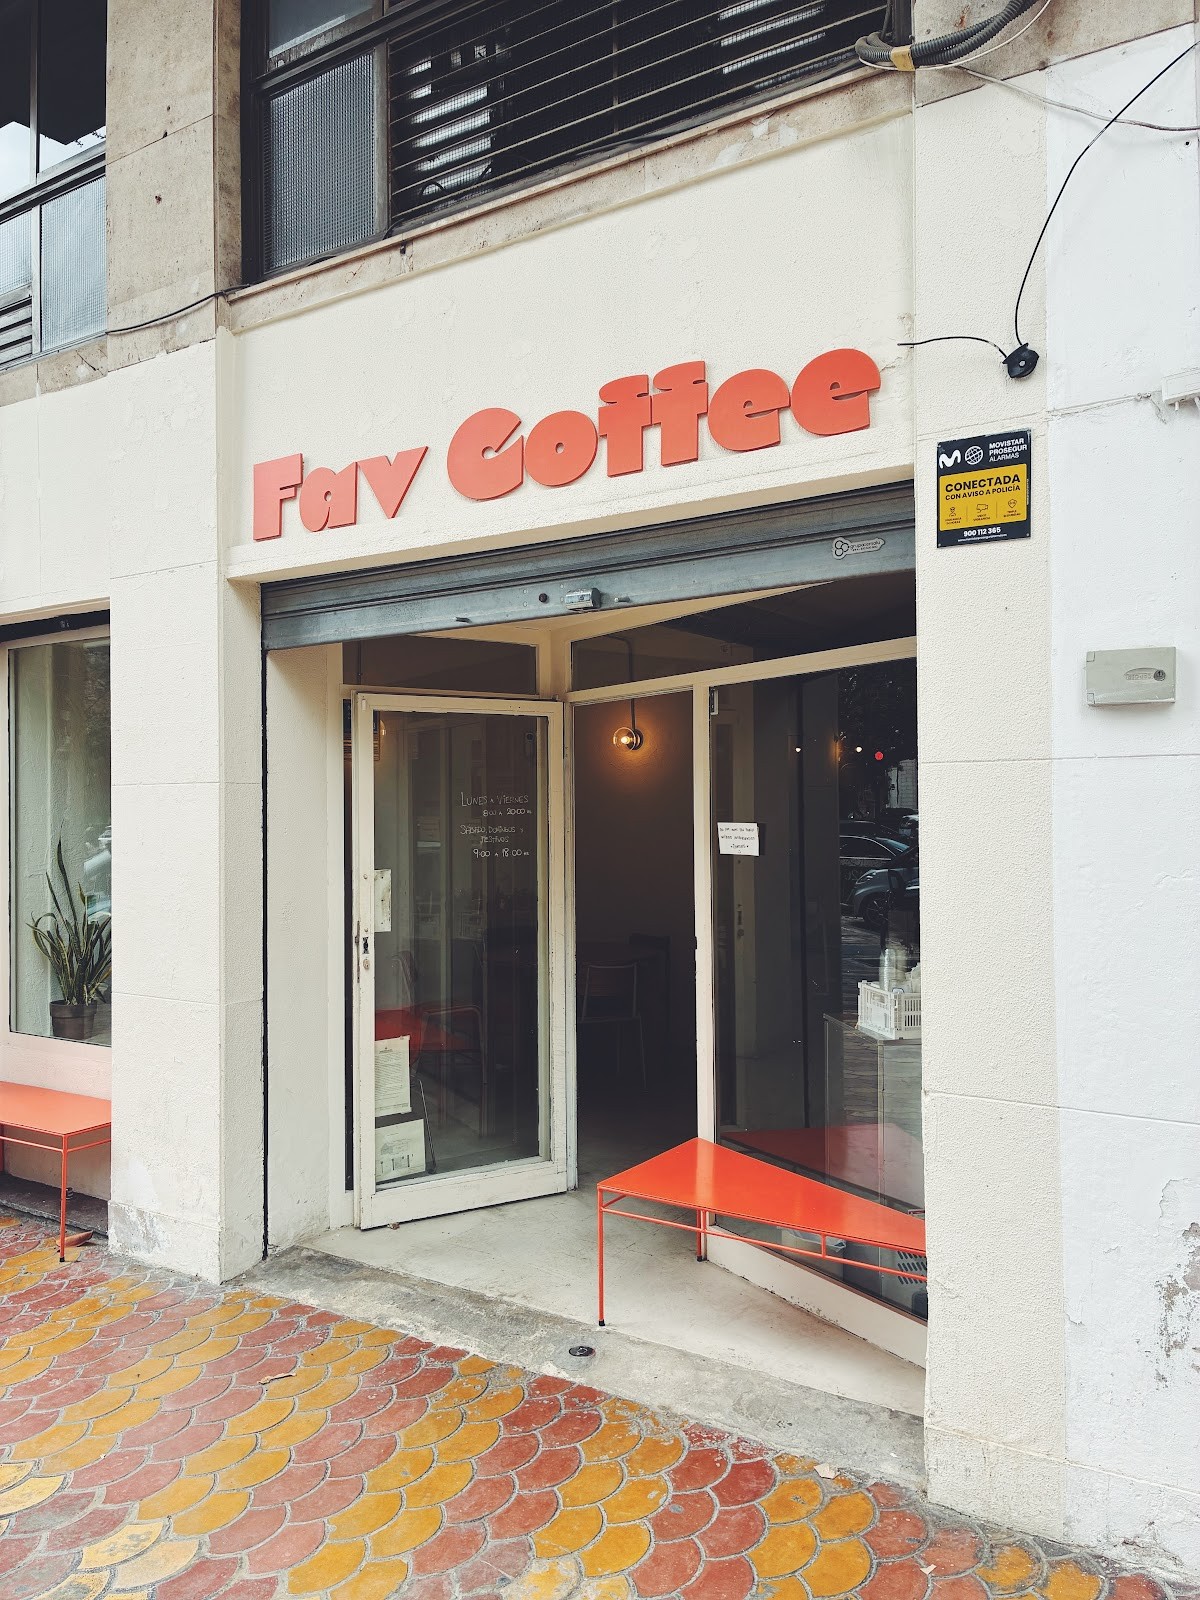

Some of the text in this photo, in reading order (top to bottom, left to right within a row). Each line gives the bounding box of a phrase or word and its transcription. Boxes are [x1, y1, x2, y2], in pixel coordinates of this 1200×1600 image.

[253, 347, 882, 541] Fav Coffee
[988, 438, 1025, 449] MOVISTAR
[988, 444, 1028, 456] PROSEGUR
[988, 452, 1020, 462] ALARMAS
[945, 473, 1021, 493] CONECTADA
[945, 493, 961, 501] CON
[962, 490, 984, 498] AVISO
[991, 484, 1021, 495] POLICÍA
[963, 526, 1002, 537] 900 112 365
[460, 791, 487, 807] LUNES
